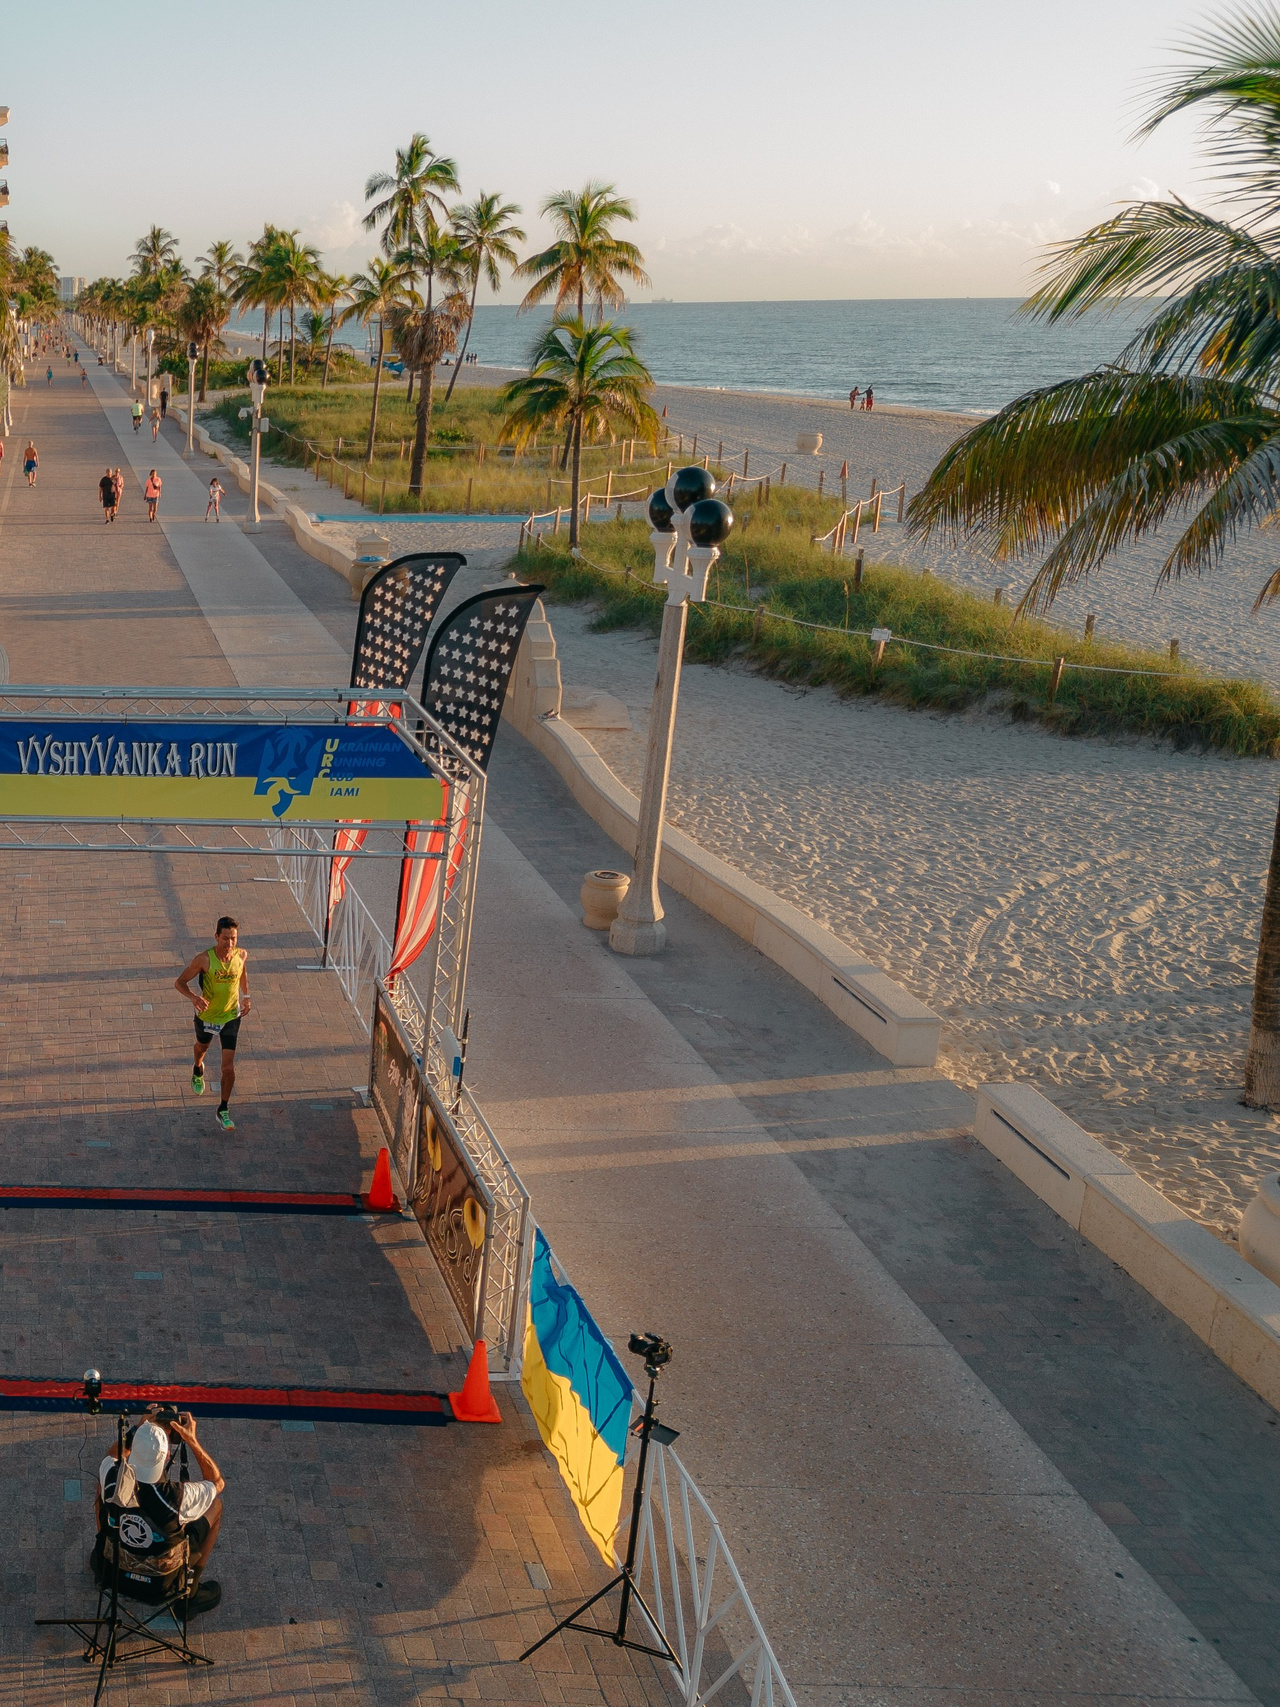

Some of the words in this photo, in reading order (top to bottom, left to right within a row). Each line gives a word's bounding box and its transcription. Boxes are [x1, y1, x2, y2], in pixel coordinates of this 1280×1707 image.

[325, 738, 402, 752] UKRAINIAN
[17, 733, 183, 777] VYSHYVANKA
[189, 742, 238, 779] RUN
[321, 754, 386, 767] RUNNING
